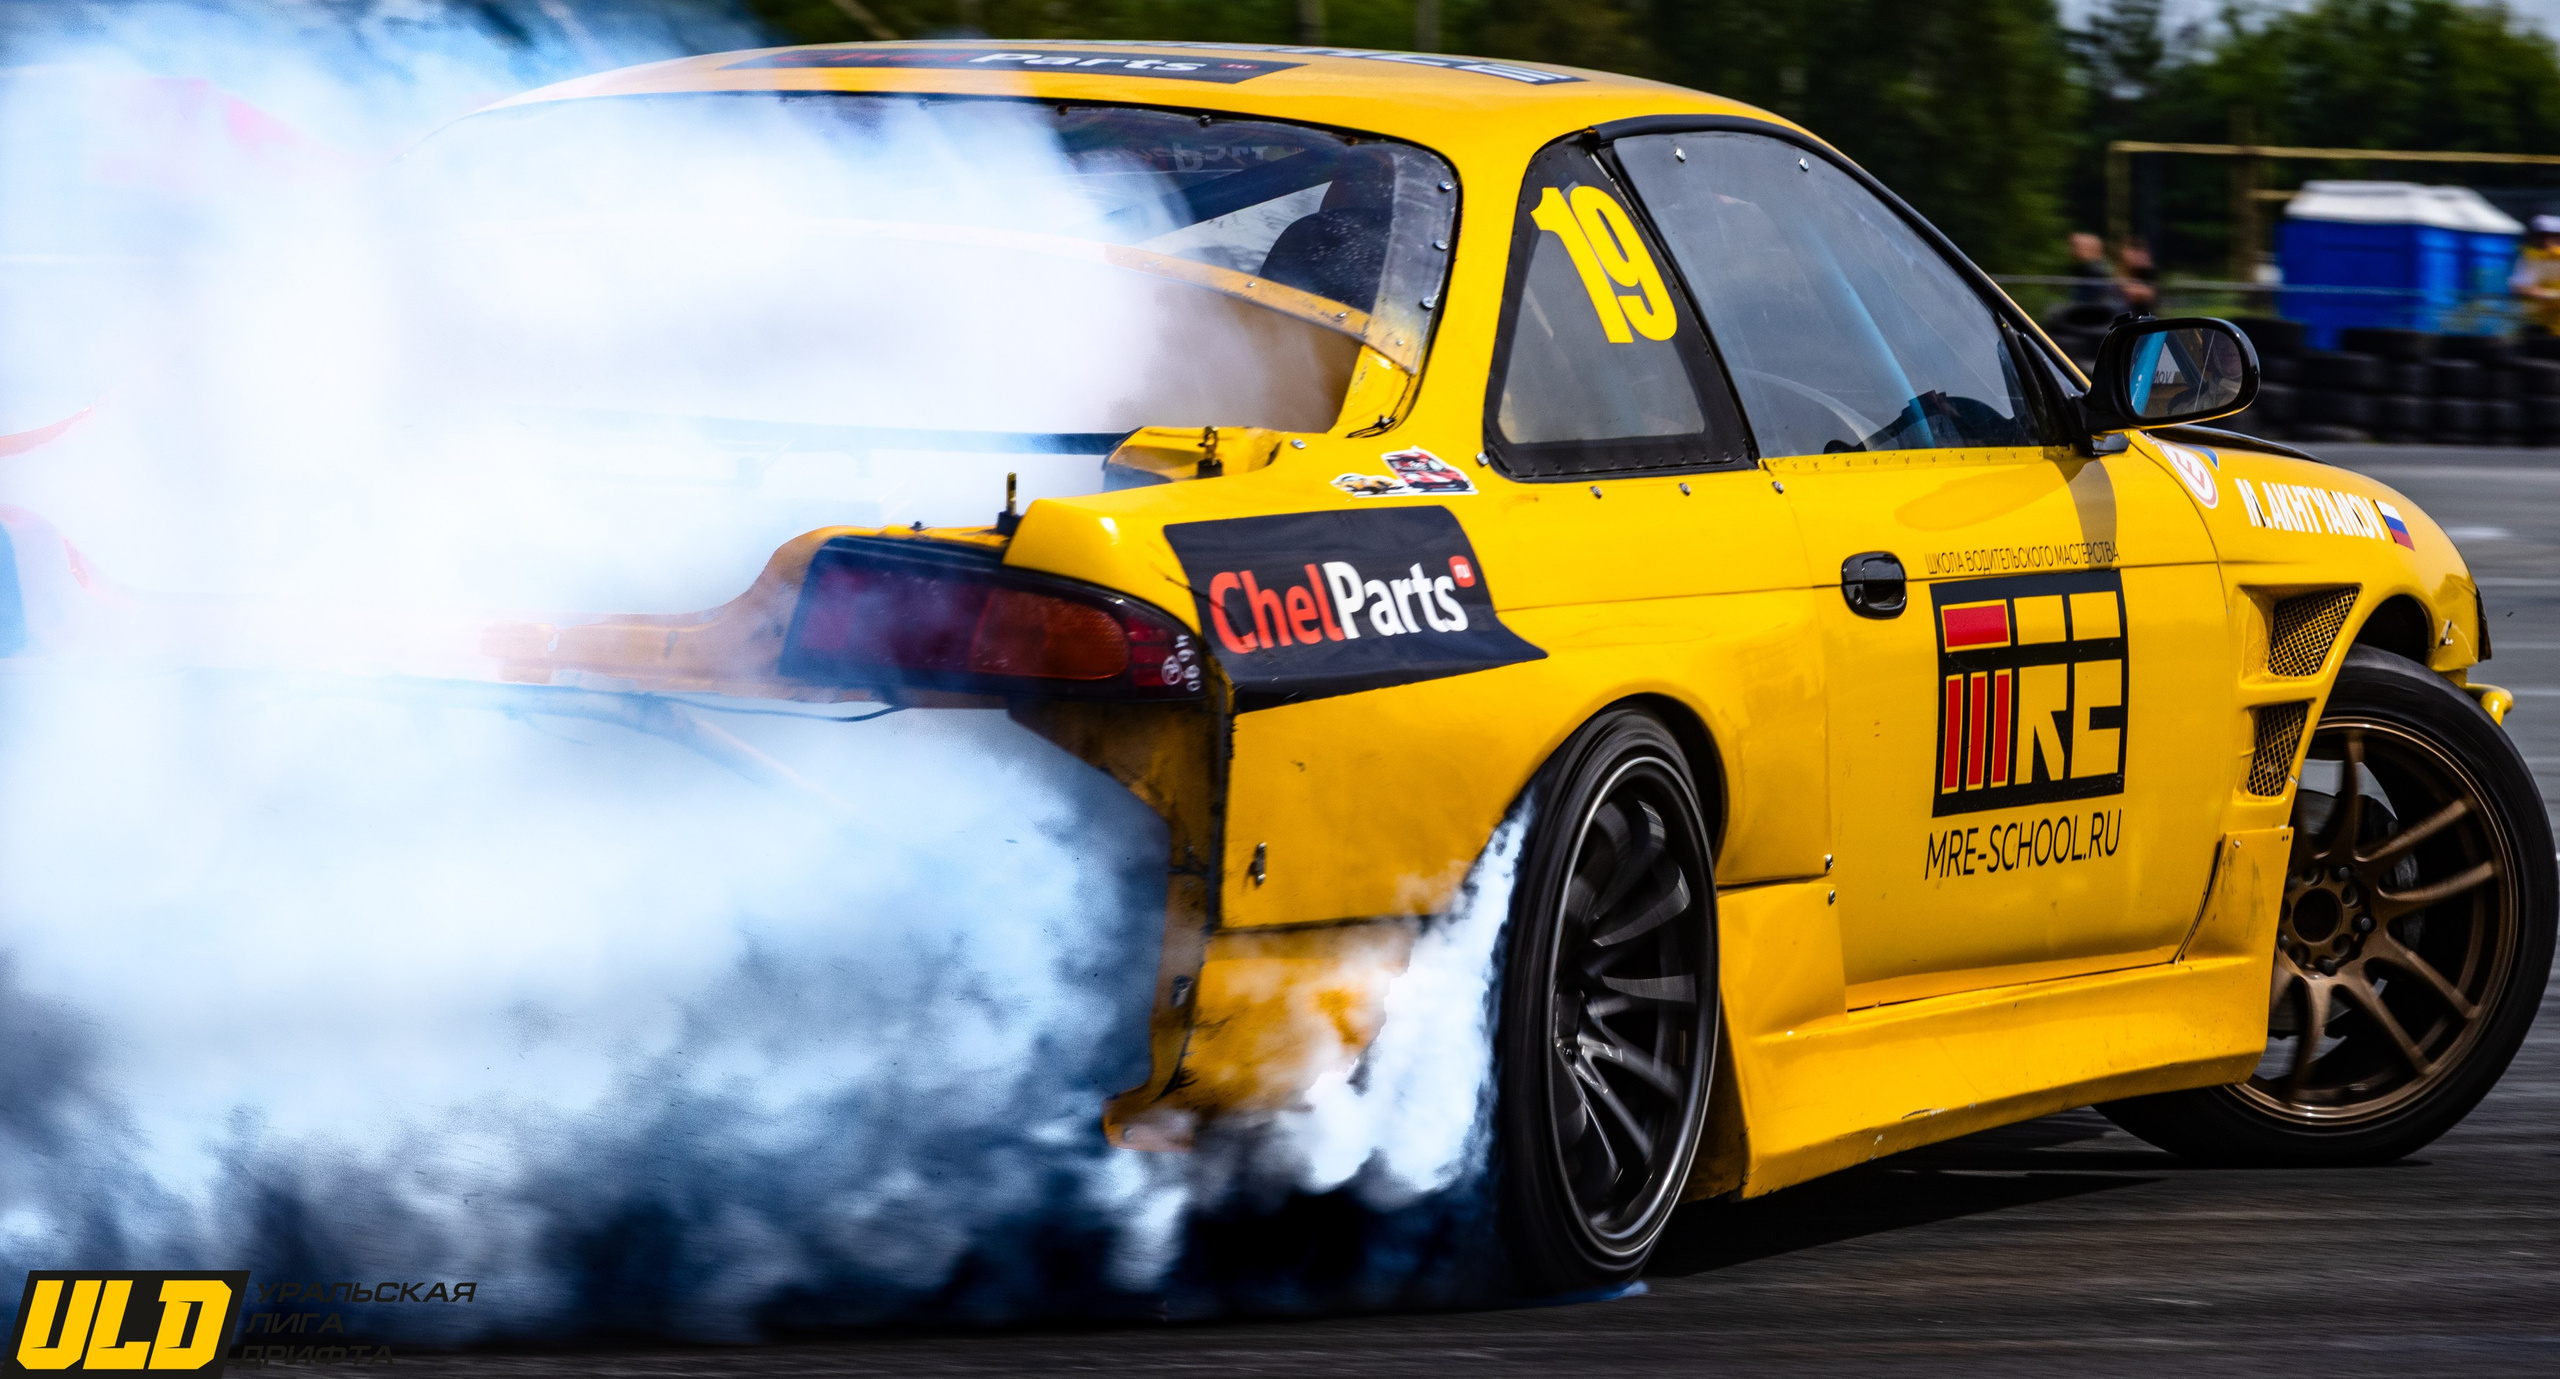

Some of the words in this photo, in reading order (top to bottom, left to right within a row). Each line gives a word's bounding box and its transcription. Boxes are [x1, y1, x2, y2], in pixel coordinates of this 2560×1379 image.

[775, 52, 1208, 71] ChelParts
[1530, 185, 1678, 343] 19
[1924, 551, 1966, 575] ШКОЛА
[1965, 545, 2054, 576] ВОДИТЕЛЬСКОГО
[2053, 540, 2121, 567] МАСТЕРСТВА
[1209, 561, 1469, 654] ChelParts
[1924, 807, 2122, 880] MRE-SCHOOL.RU
